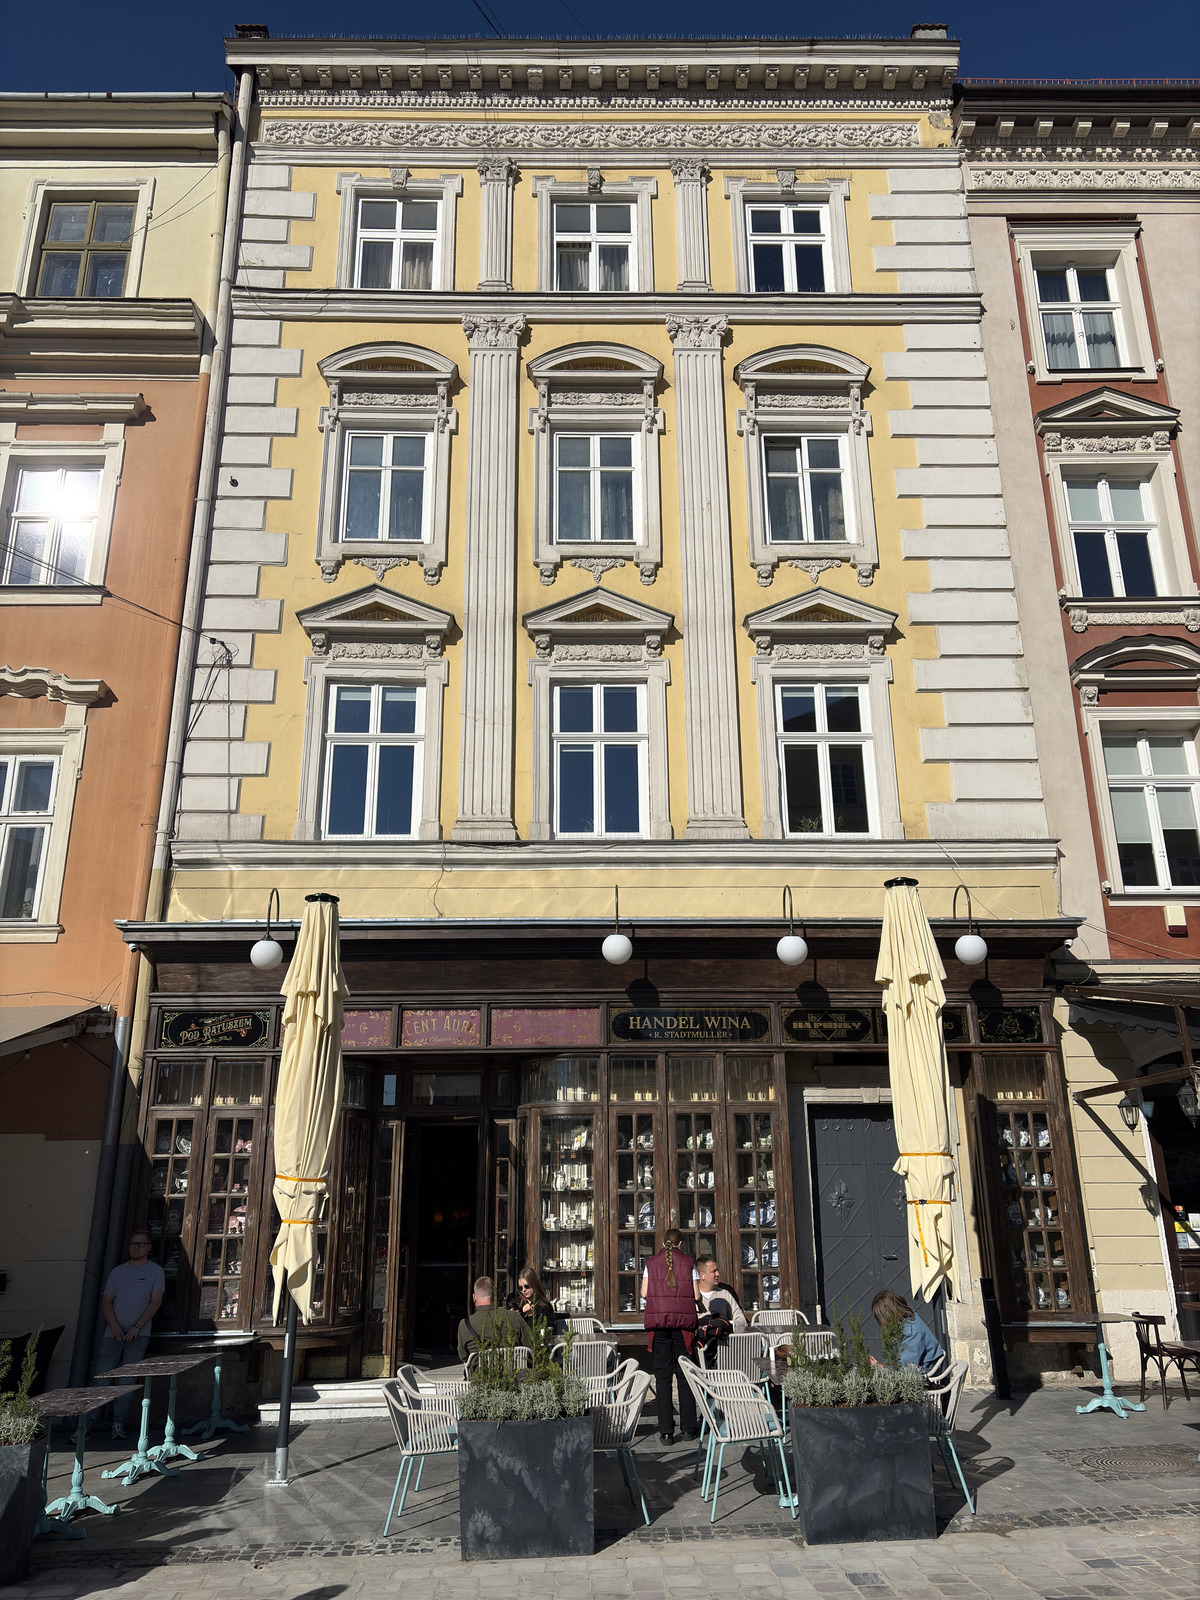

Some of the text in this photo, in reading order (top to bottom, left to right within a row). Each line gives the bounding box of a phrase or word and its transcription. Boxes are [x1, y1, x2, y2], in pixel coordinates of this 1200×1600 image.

[404, 1015, 476, 1036] CENT AURA
[629, 1016, 751, 1029] HANDEL WINA
[180, 1018, 252, 1045] POD RATUSZEM
[664, 1031, 728, 1039] STADTMULLER
